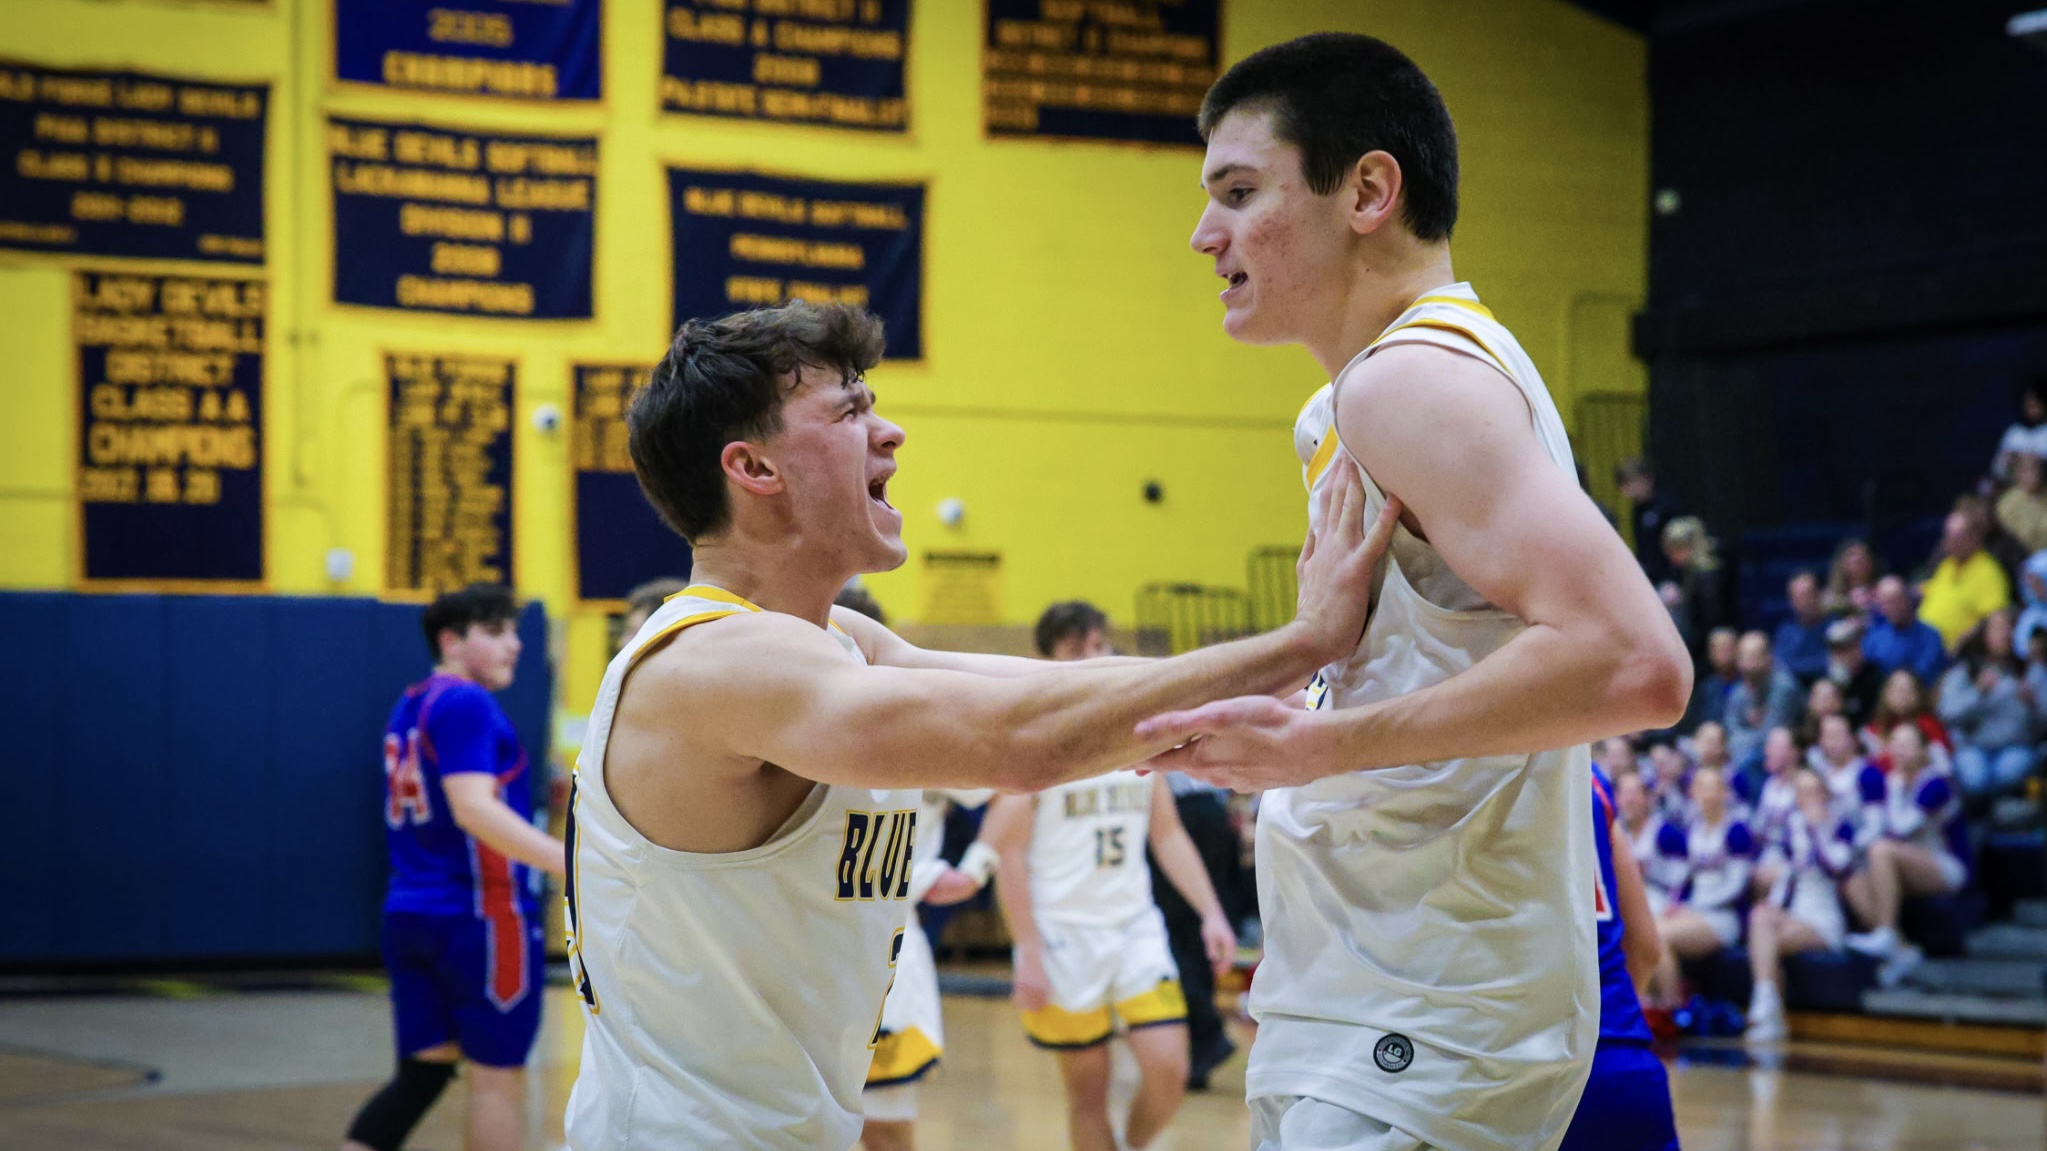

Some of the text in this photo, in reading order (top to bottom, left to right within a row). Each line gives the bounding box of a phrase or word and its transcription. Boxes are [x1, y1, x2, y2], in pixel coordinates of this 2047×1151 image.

[90, 383, 195, 421] CLASS
[88, 421, 256, 470] CHAMPIONS
[834, 808, 917, 901] BLUE
[1095, 825, 1126, 868] 15
[1387, 1043, 1403, 1057] LG
